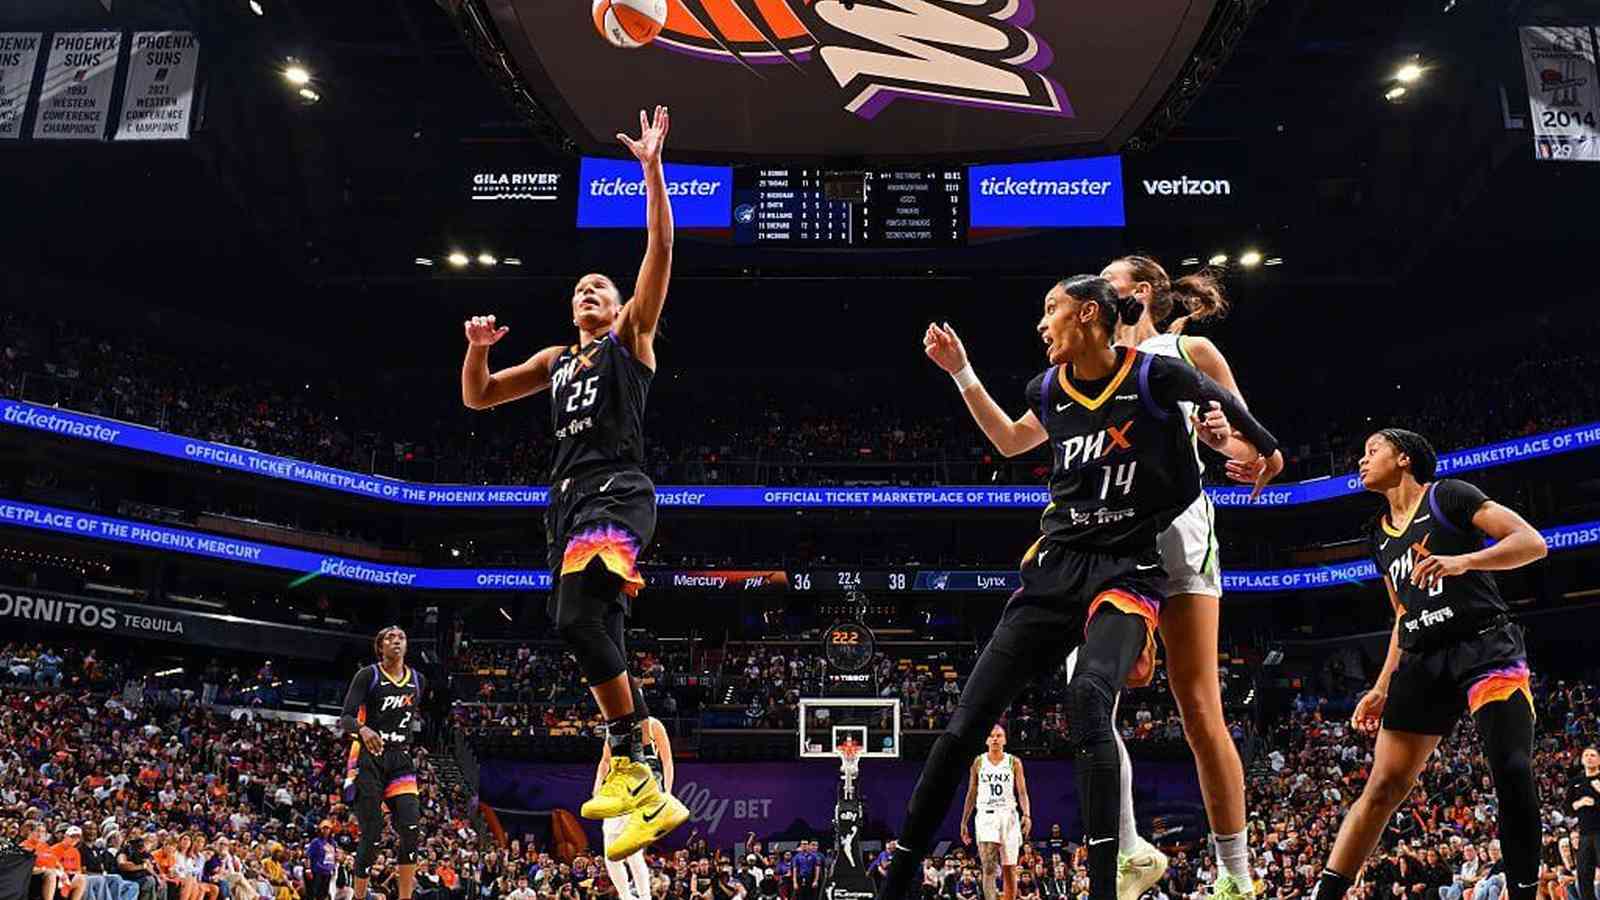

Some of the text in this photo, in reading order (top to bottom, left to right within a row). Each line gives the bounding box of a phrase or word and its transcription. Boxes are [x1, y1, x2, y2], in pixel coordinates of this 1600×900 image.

[55, 36, 118, 50] PHOENIX
[137, 35, 194, 49] PHOENIX
[64, 53, 101, 66] SUNS
[146, 52, 181, 66] SUNS
[127, 122, 179, 133] CAMPIONS
[1542, 111, 1595, 127] 2014
[473, 174, 558, 184] GILA RIVER
[590, 177, 720, 197] ticketaster
[979, 176, 1111, 196] ticketmaster
[1143, 175, 1231, 195] verizon
[552, 347, 599, 399] PHX
[566, 375, 600, 412] 25
[4, 404, 121, 442] ticketmaster
[1062, 421, 1134, 470] PHX
[1452, 440, 1551, 468] MARKETPLACE
[1553, 434, 1572, 448] OF
[1575, 428, 1600, 443] THE
[185, 444, 548, 502] OFFICIAL TICKET MARKETPLACE OF THE PHOENIX MERCURY
[1101, 461, 1137, 500] 14
[764, 492, 823, 502] OFFICIAL
[826, 492, 869, 502] TICKET
[872, 492, 964, 502] MARKETPLACE
[966, 492, 984, 502] OF
[987, 492, 1011, 502] THE
[76, 519, 98, 531] OF
[101, 522, 129, 537] THE
[131, 527, 194, 548] PHOENIX
[197, 539, 261, 559] MERCURY
[320, 558, 417, 585] ticketmaster
[477, 575, 535, 585] OFFICIAL
[1283, 574, 1300, 585] OF
[1303, 571, 1329, 583] THE
[674, 575, 727, 589] Mercury
[794, 572, 1006, 591] 36 22.4 38 Lynx
[125, 614, 184, 634] TEQUILA
[381, 694, 414, 711] PHX
[399, 711, 412, 728] 2
[981, 773, 1010, 782] LYNX
[990, 784, 1003, 796] 10
[734, 799, 773, 819] BET
